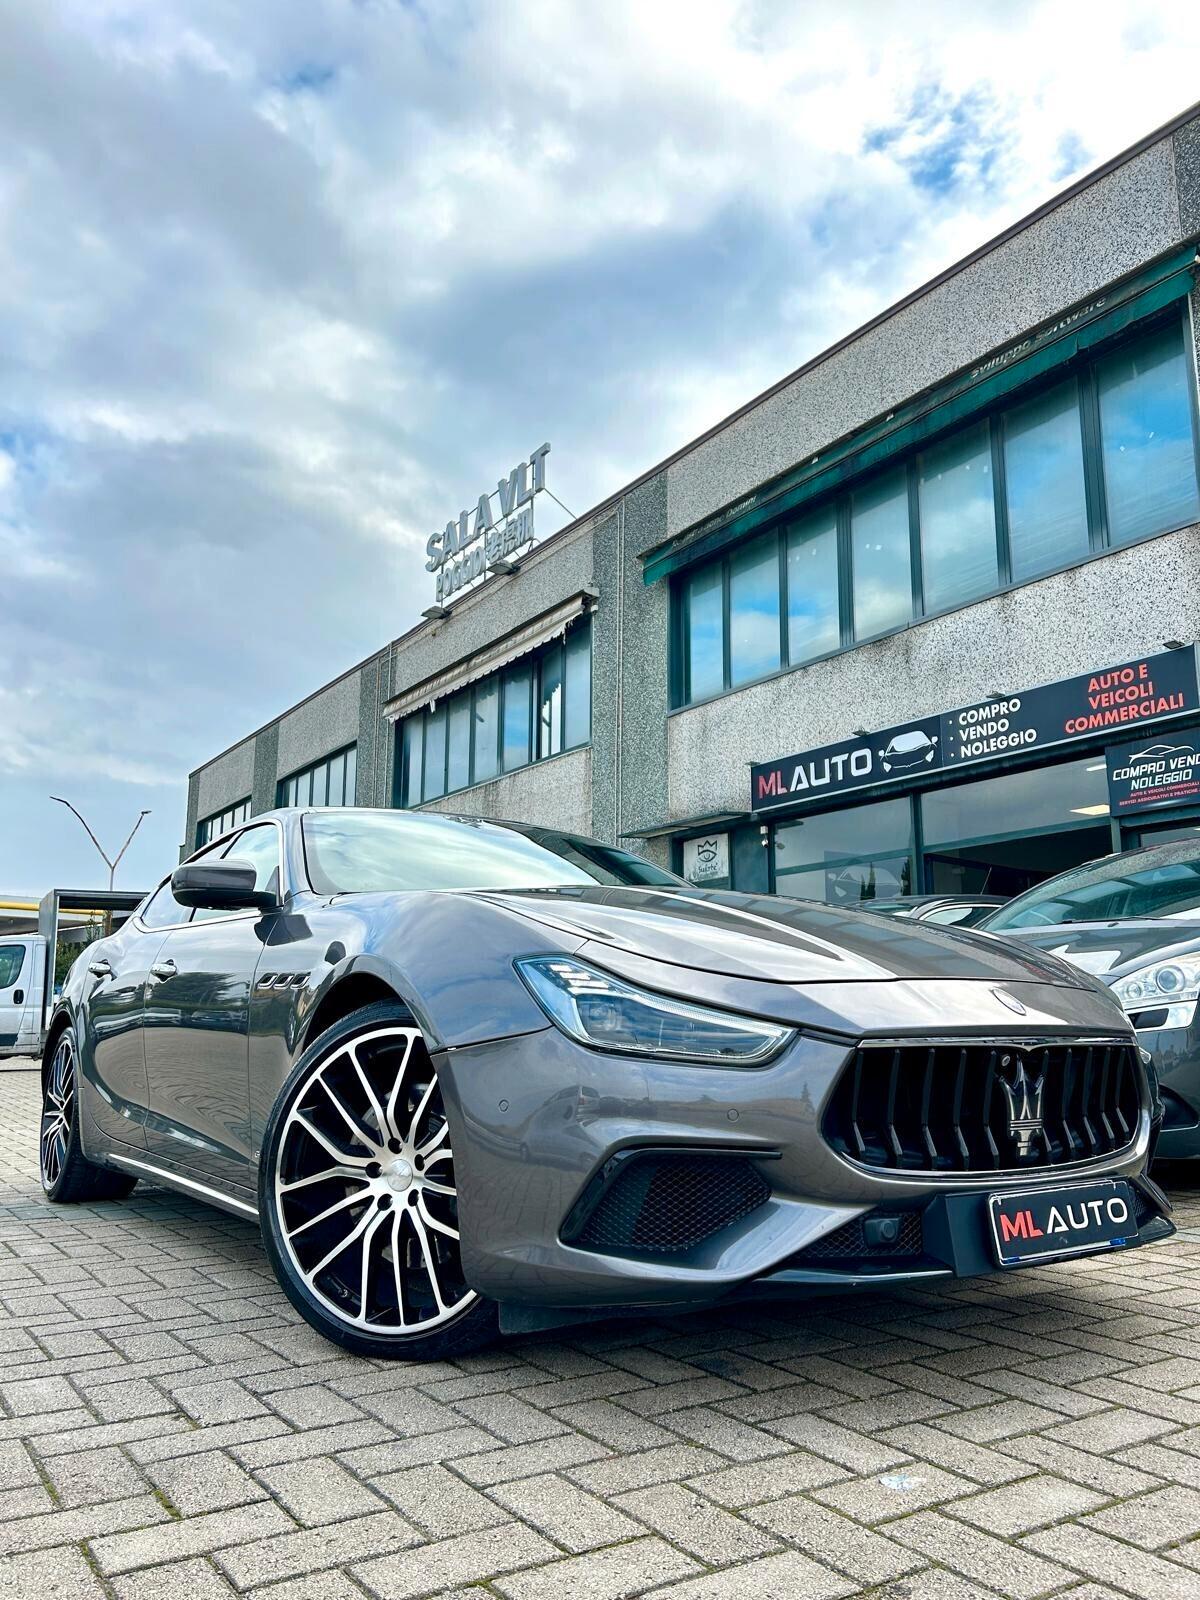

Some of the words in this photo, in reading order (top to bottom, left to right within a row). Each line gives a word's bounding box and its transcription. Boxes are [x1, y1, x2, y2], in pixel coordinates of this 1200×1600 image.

[425, 493, 493, 573] SALA
[498, 442, 551, 518] VLT
[1087, 673, 1135, 693] AUTO
[1138, 663, 1148, 679] E
[1088, 681, 1154, 710] VEICOLI
[958, 698, 1021, 726] COMPRO
[1064, 692, 1184, 735] COMMERCIALI
[959, 718, 1010, 742] VENDO
[960, 728, 1037, 759] NOLEGGIO
[1112, 760, 1166, 781] COMPRO
[1130, 768, 1193, 791] NOLEGGIO
